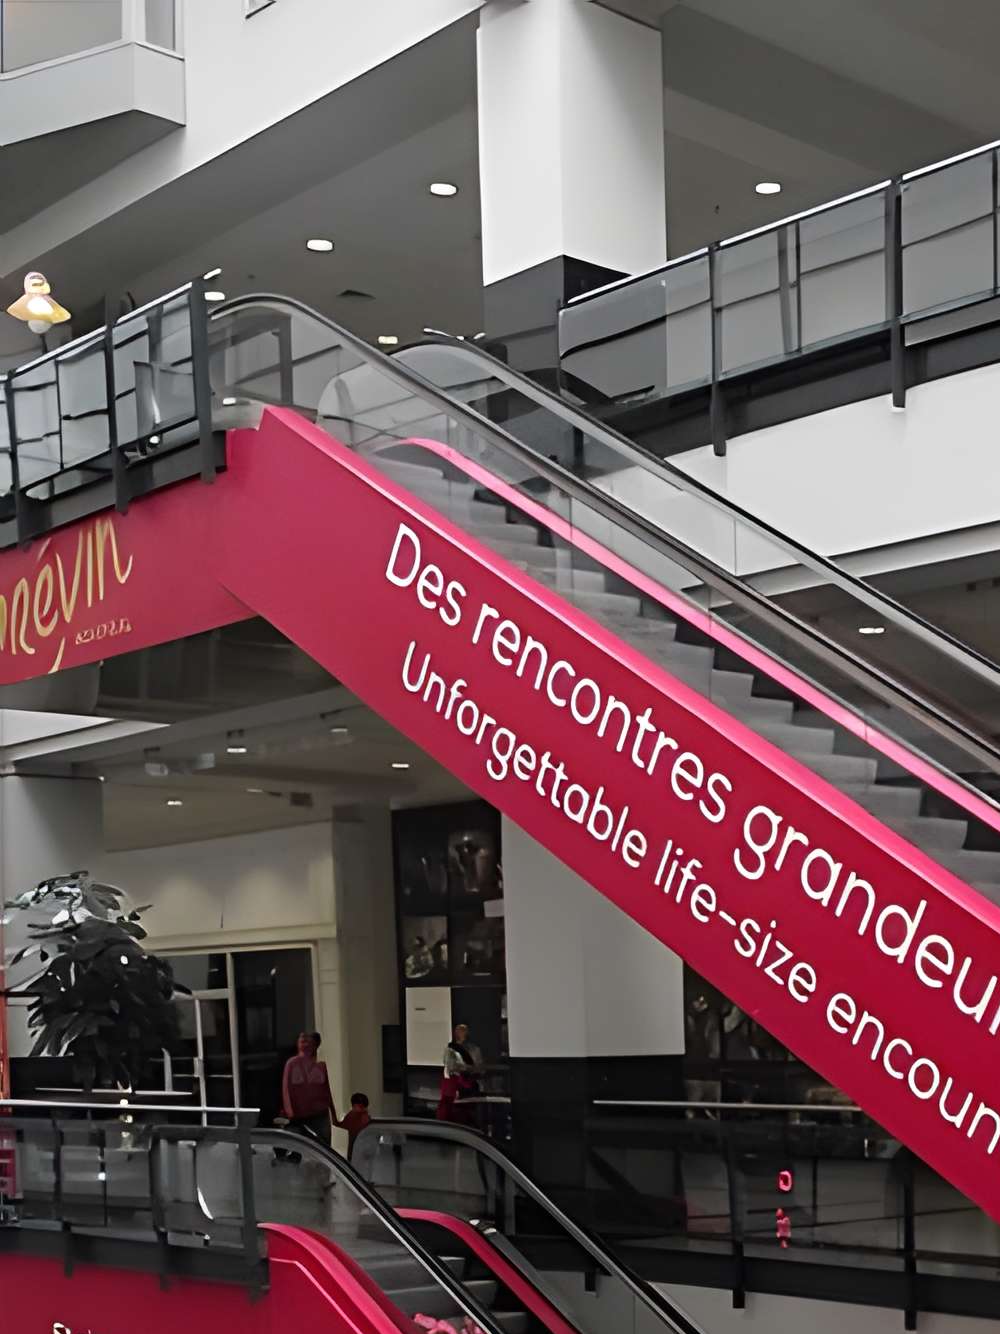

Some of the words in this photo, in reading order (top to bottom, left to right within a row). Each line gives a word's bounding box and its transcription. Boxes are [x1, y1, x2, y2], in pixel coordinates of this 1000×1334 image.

[385, 522, 467, 627] Des
[471, 602, 733, 823] rencontres
[401, 640, 648, 868] Unforgettable
[654, 839, 817, 1003] life-size
